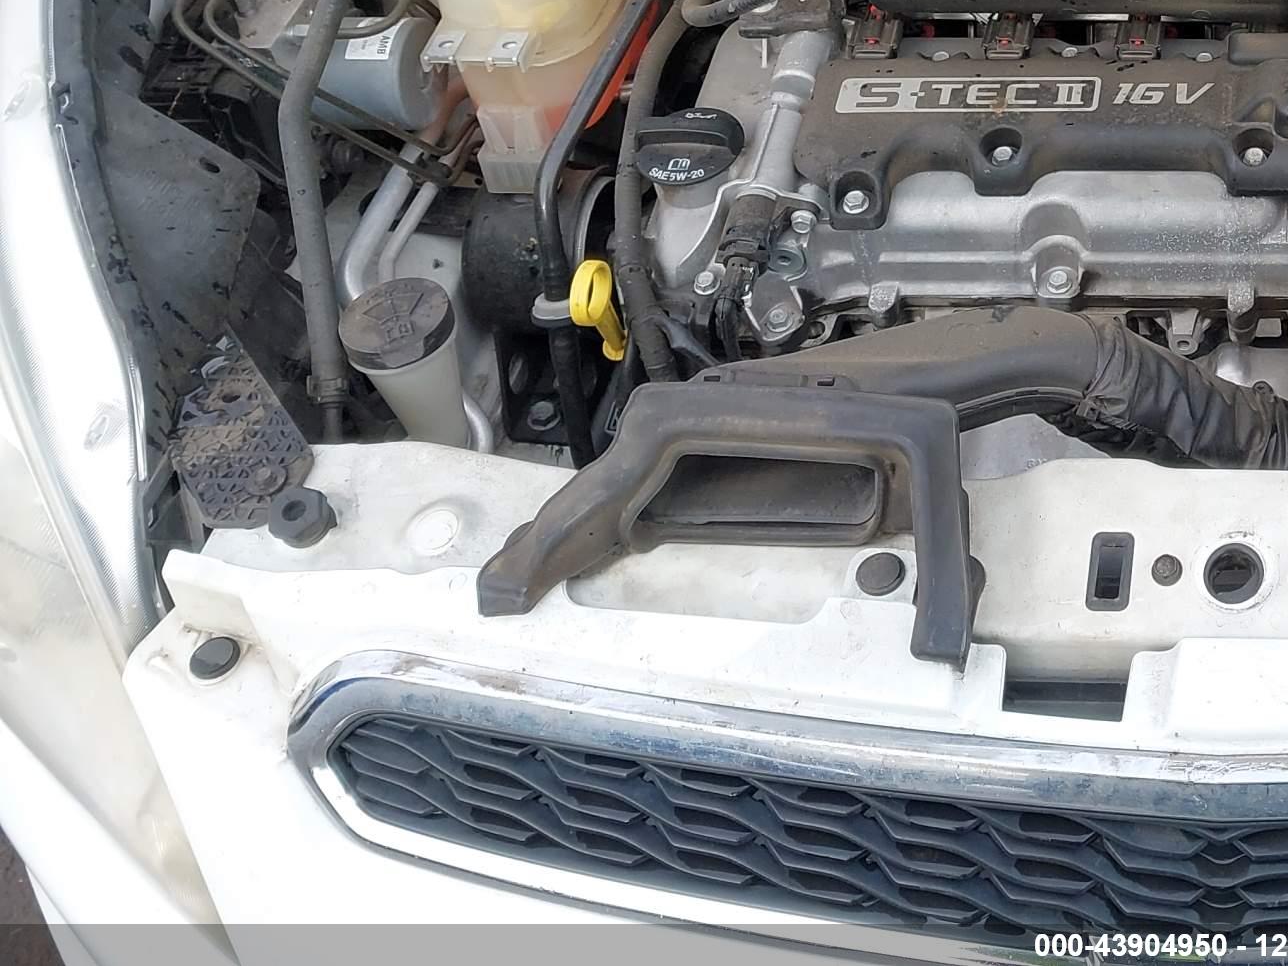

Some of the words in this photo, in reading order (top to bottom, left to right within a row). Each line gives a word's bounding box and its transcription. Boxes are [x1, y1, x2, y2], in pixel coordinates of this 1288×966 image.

[1112, 82, 1216, 106] 16V
[648, 166, 671, 181] SAE
[669, 168, 705, 181] 5W-20
